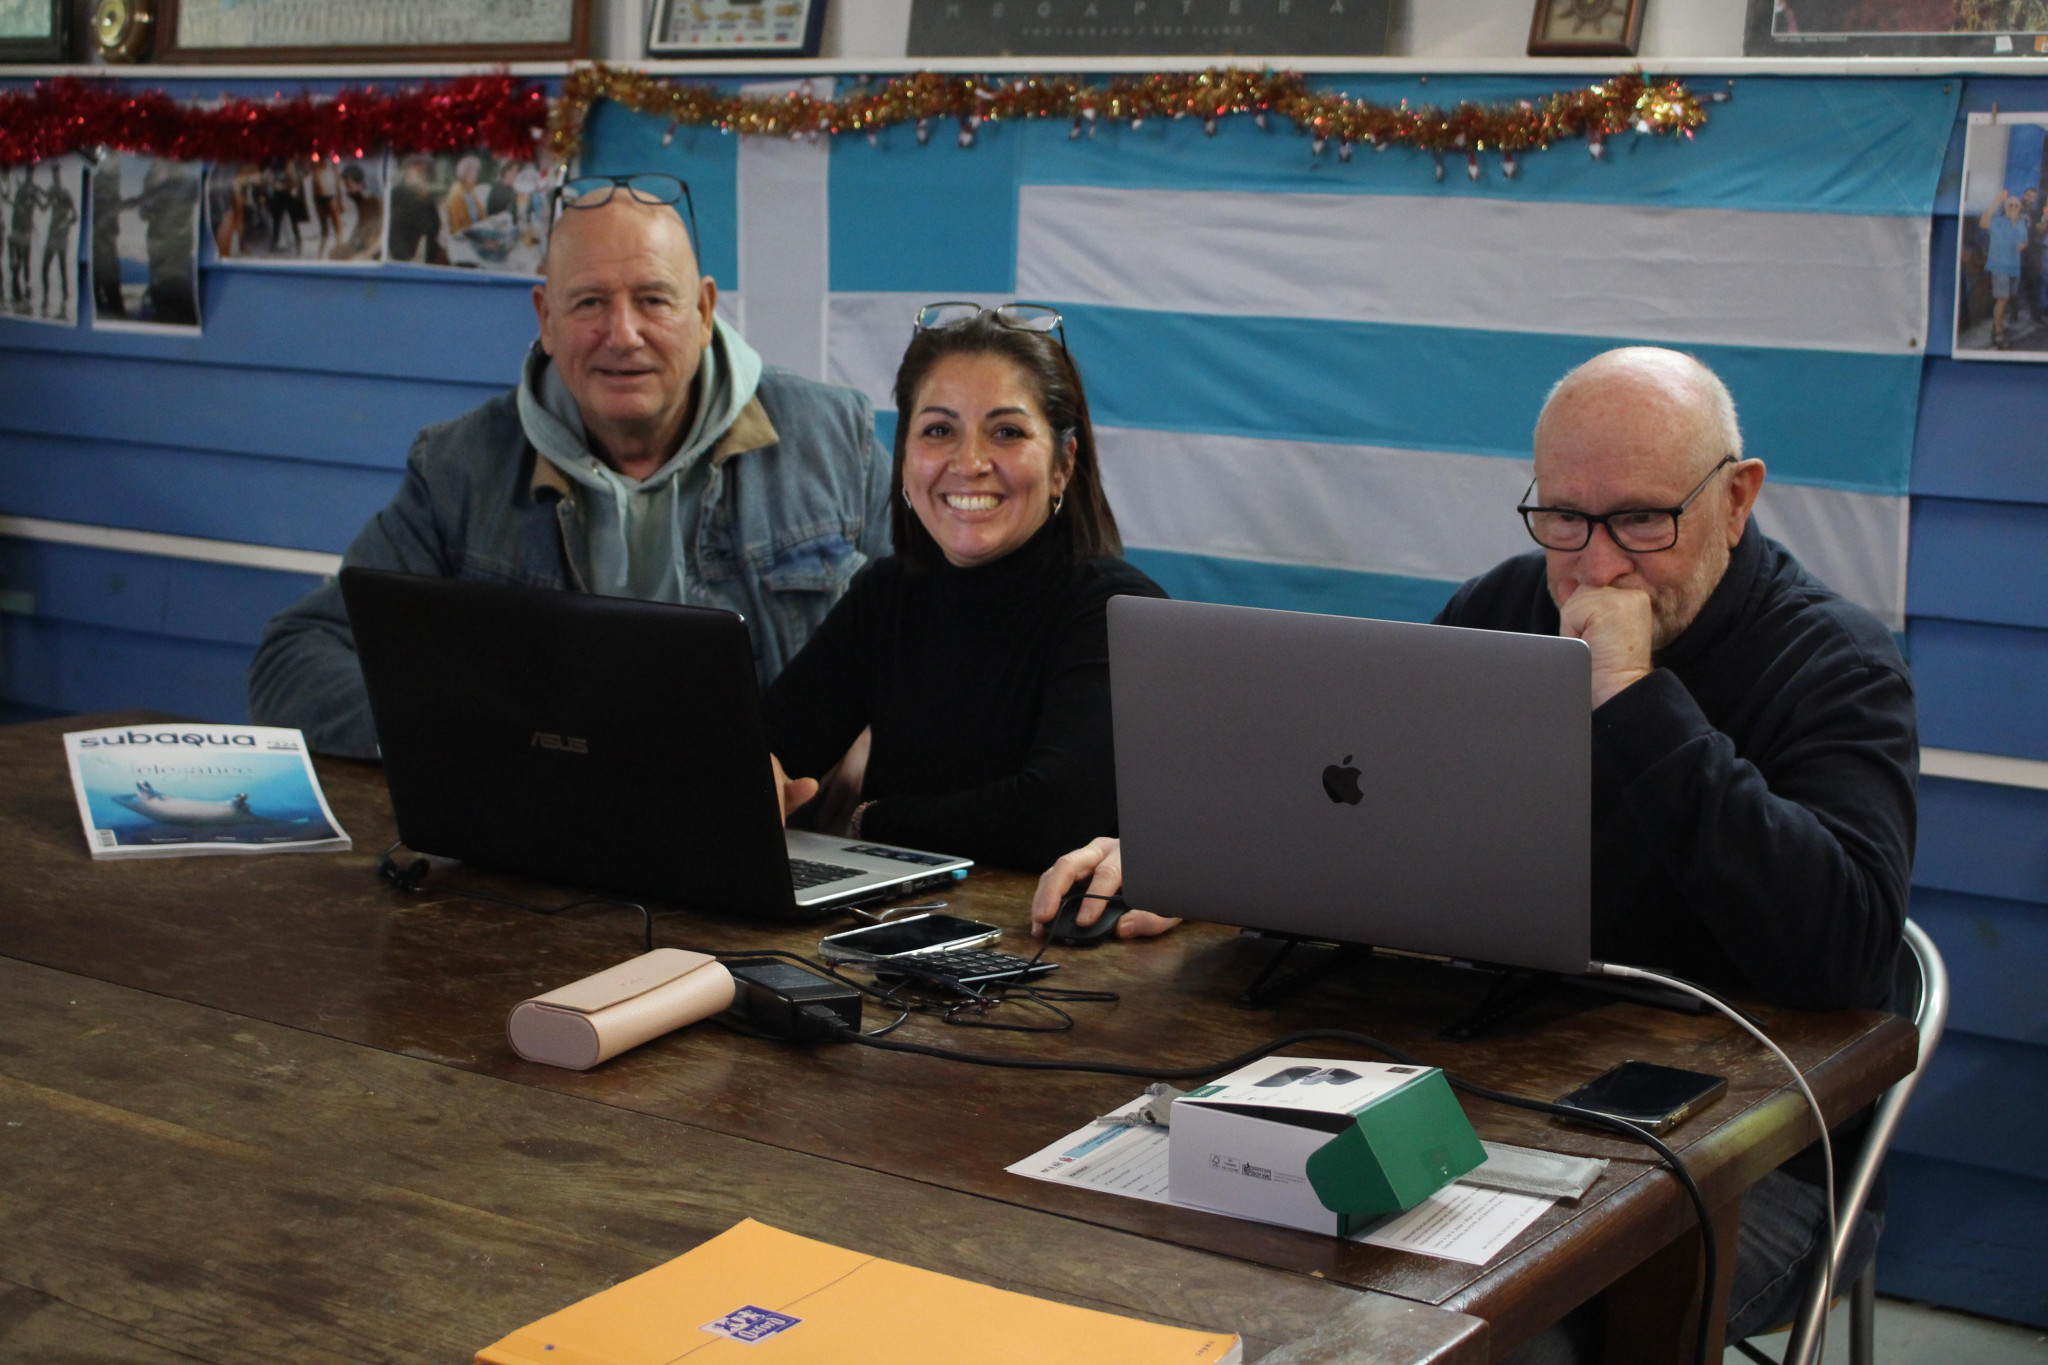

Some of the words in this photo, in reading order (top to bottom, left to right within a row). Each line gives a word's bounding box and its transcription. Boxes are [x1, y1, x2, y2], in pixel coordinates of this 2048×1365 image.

[946, 0, 1342, 17] MEGAPTERA
[80, 731, 256, 749] subaqua
[530, 731, 588, 754] ASUS
[738, 1317, 786, 1339] Oxford
